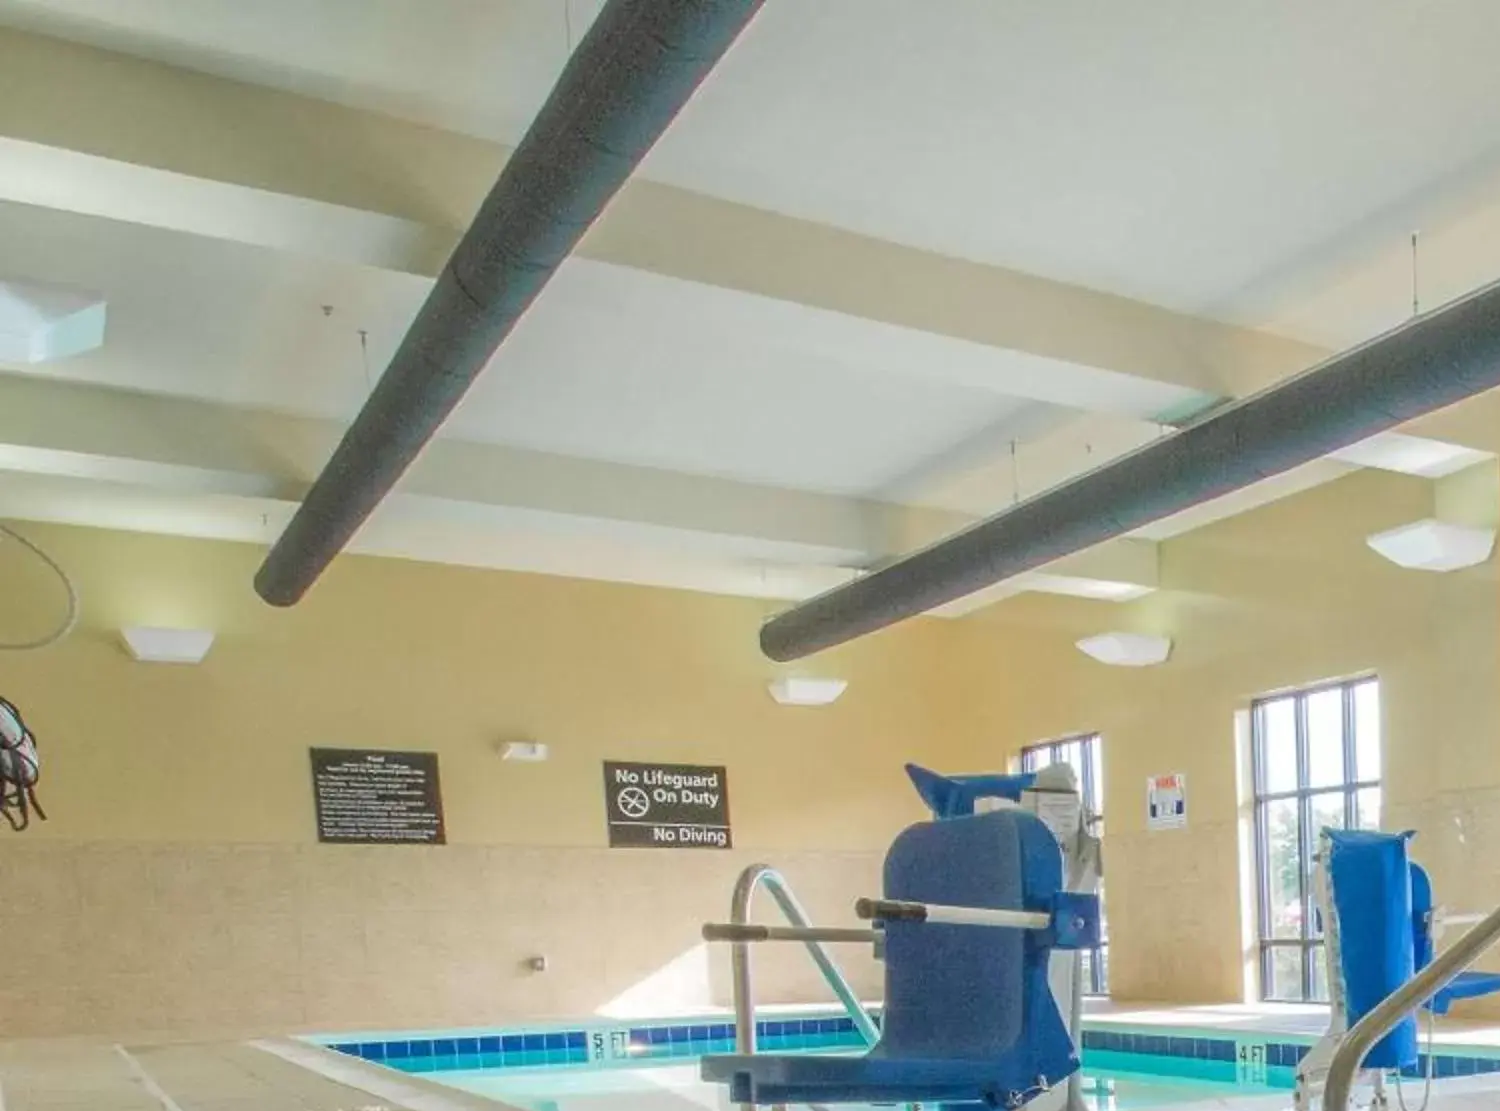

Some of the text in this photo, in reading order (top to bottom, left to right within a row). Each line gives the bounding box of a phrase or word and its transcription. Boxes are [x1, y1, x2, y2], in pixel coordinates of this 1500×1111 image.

[615, 769, 718, 789] No Lifeguard
[653, 788, 719, 808] On Duty
[653, 827, 727, 847] No Diving
[610, 1031, 627, 1049] FT
[1239, 1045, 1264, 1063] 4 FT
